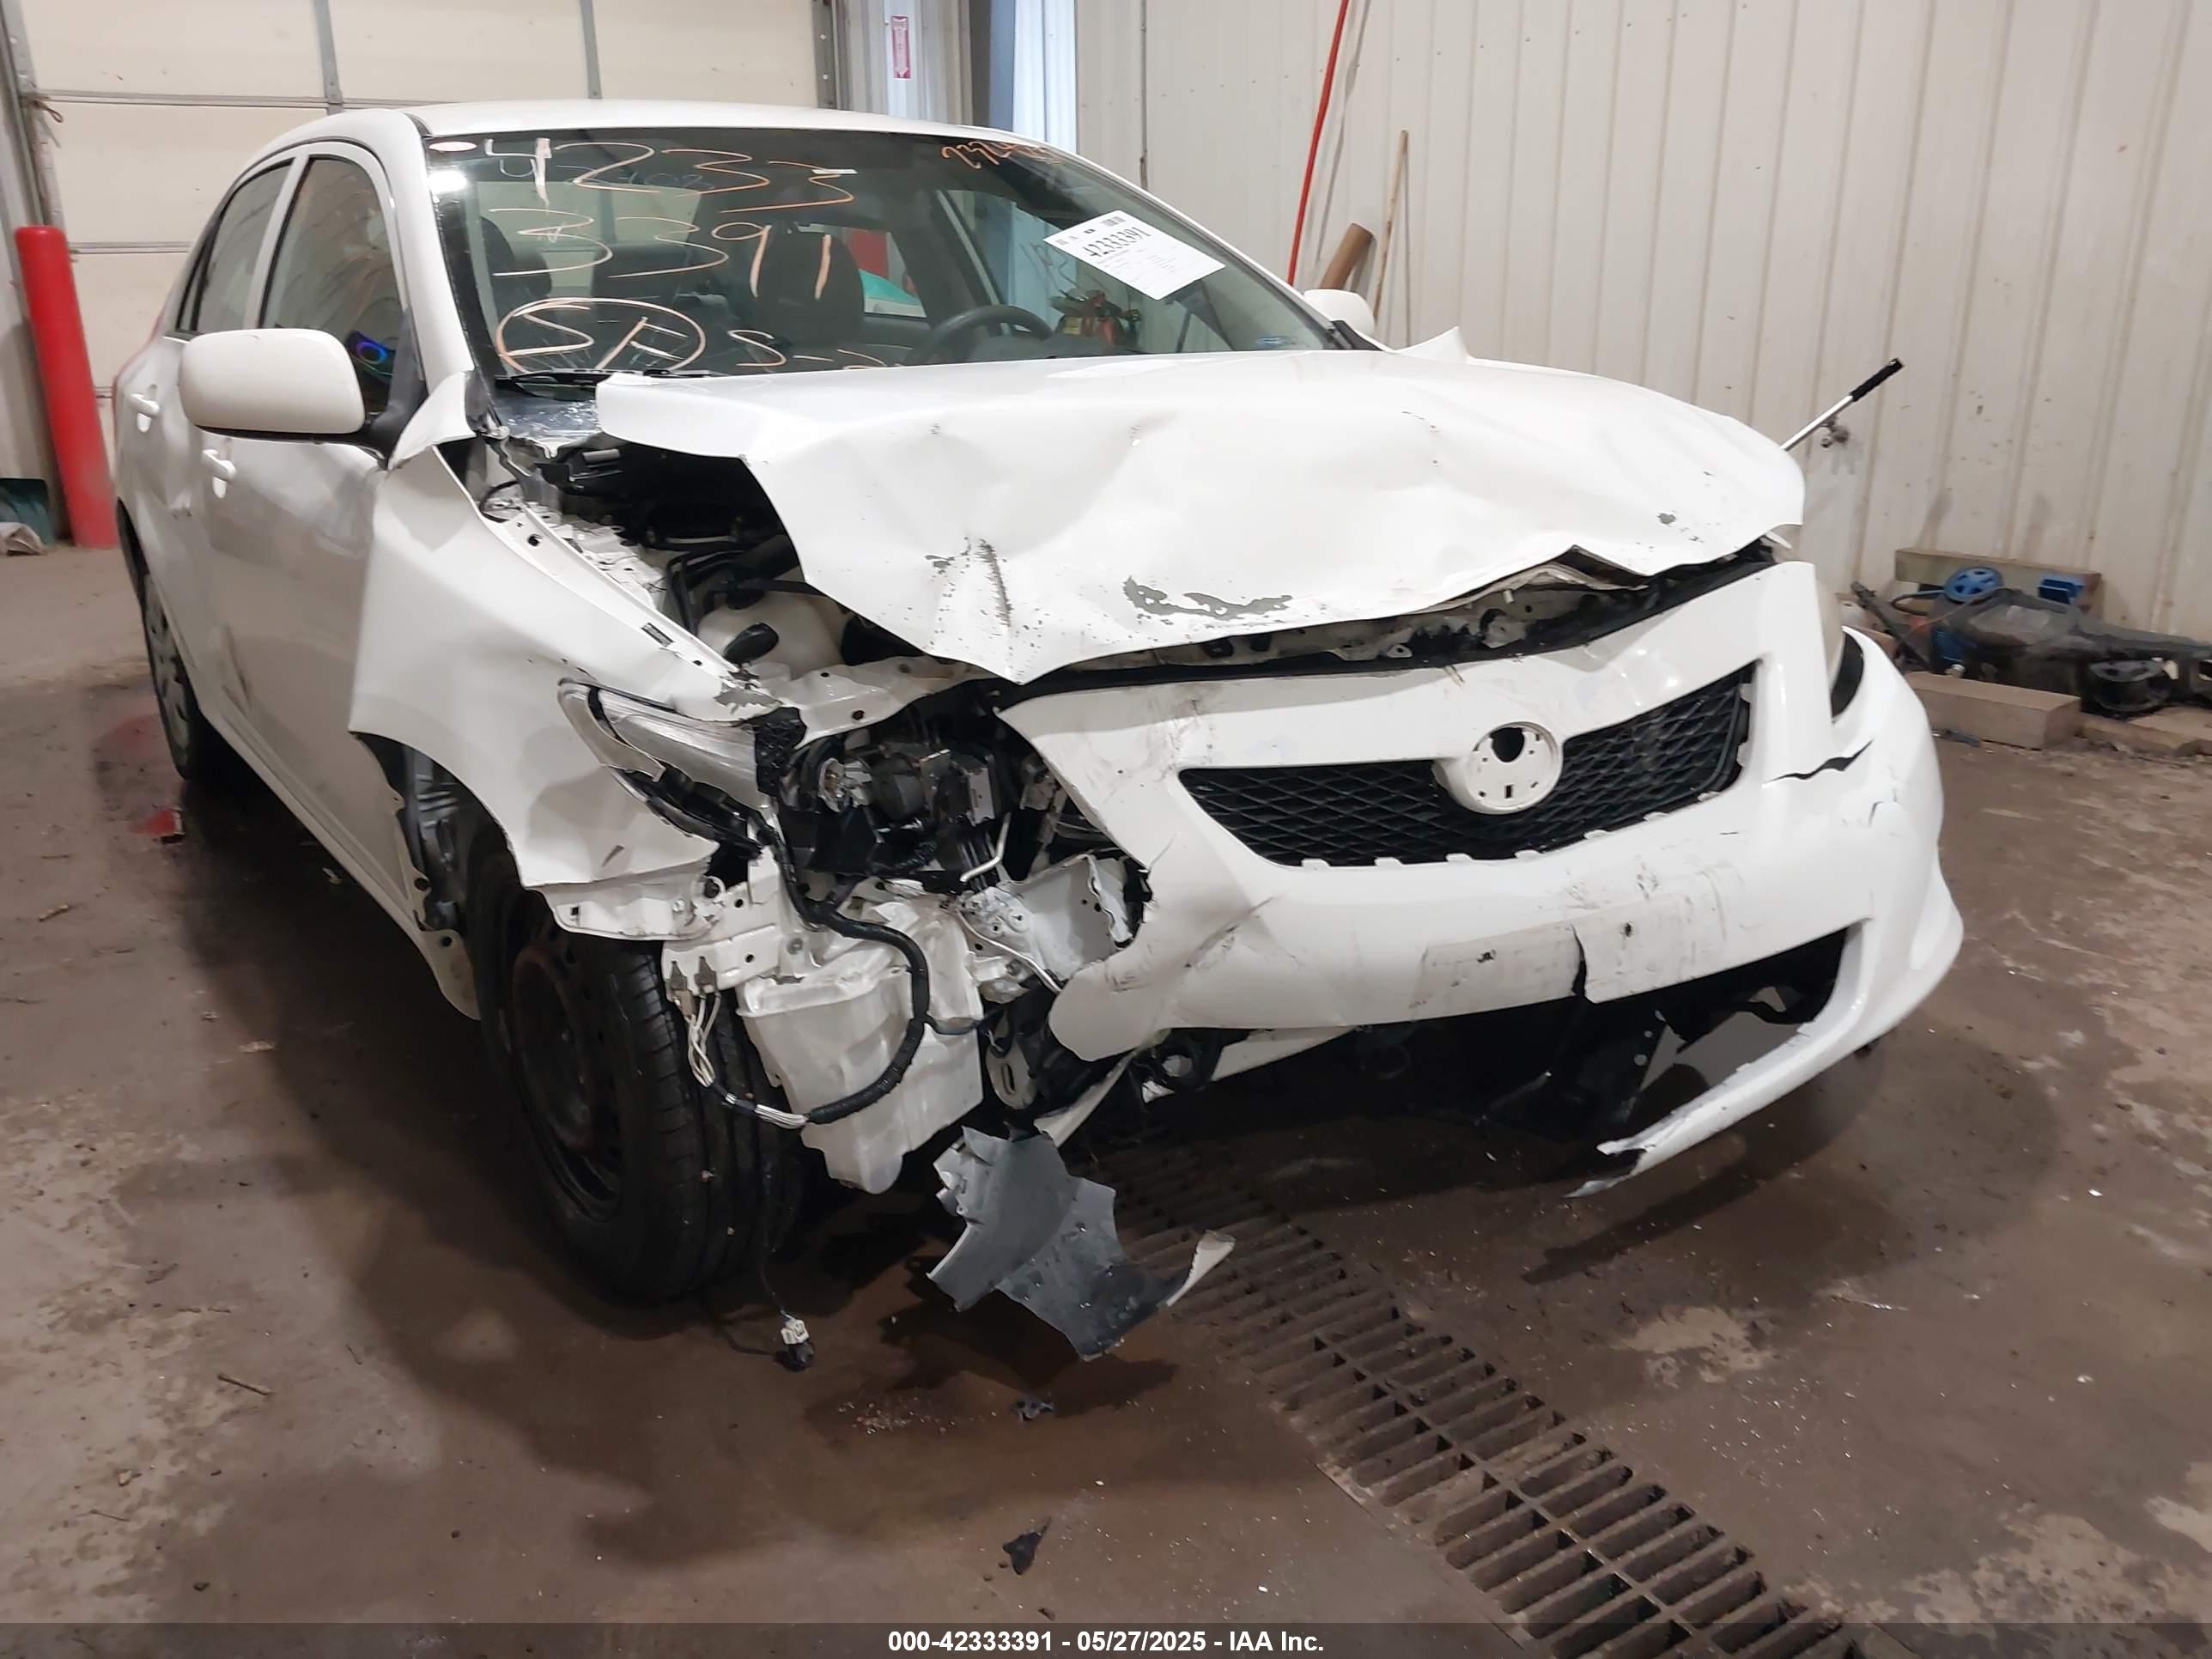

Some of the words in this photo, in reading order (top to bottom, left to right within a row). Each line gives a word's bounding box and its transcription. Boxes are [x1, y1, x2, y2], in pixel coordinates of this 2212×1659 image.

[483, 137, 855, 213] 4233
[488, 208, 832, 301] 3391
[1082, 226, 1152, 257] 42333391
